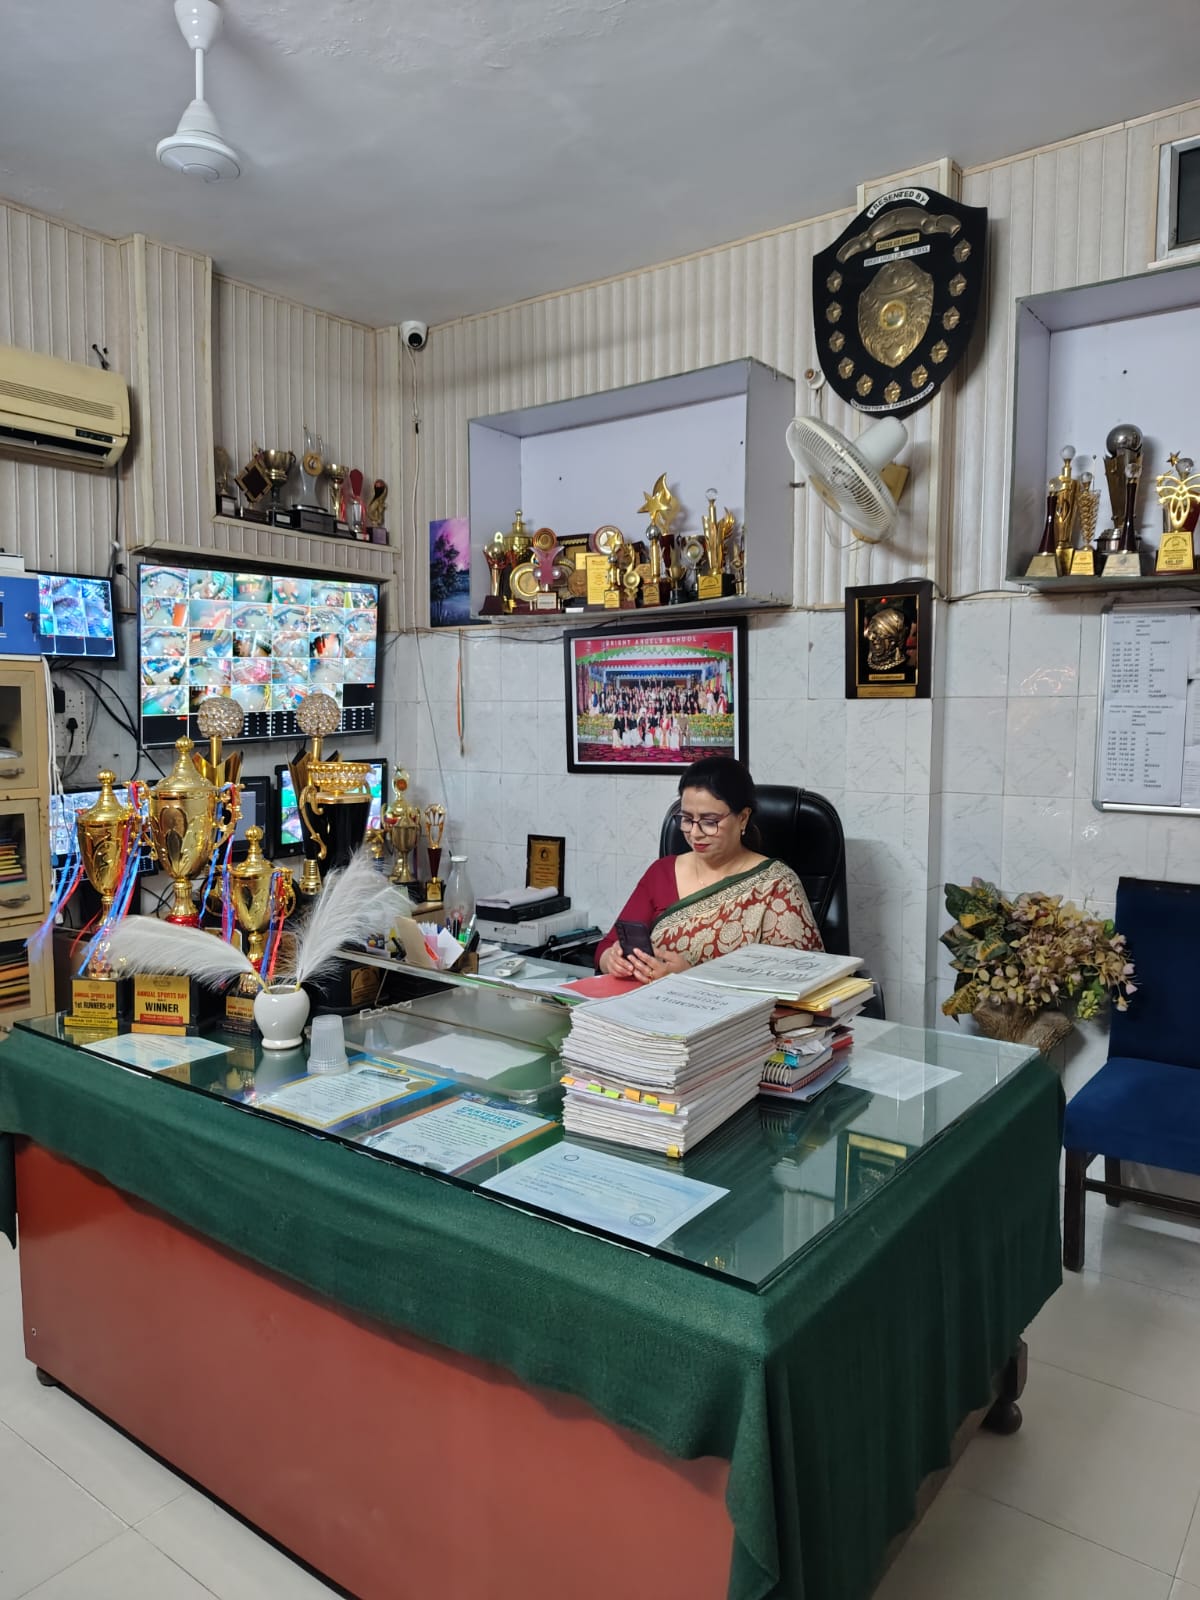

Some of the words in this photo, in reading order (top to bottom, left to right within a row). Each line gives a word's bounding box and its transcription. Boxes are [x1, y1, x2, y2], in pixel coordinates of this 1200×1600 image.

[869, 191, 915, 216] PRESENTED
[915, 192, 927, 204] BY
[666, 635, 697, 644] SCHOOL
[74, 1001, 83, 1009] 1st
[83, 1001, 115, 1010] RUNNERS-UP
[145, 1002, 179, 1013] WINNER
[462, 1106, 523, 1127] CERTIFICATE
